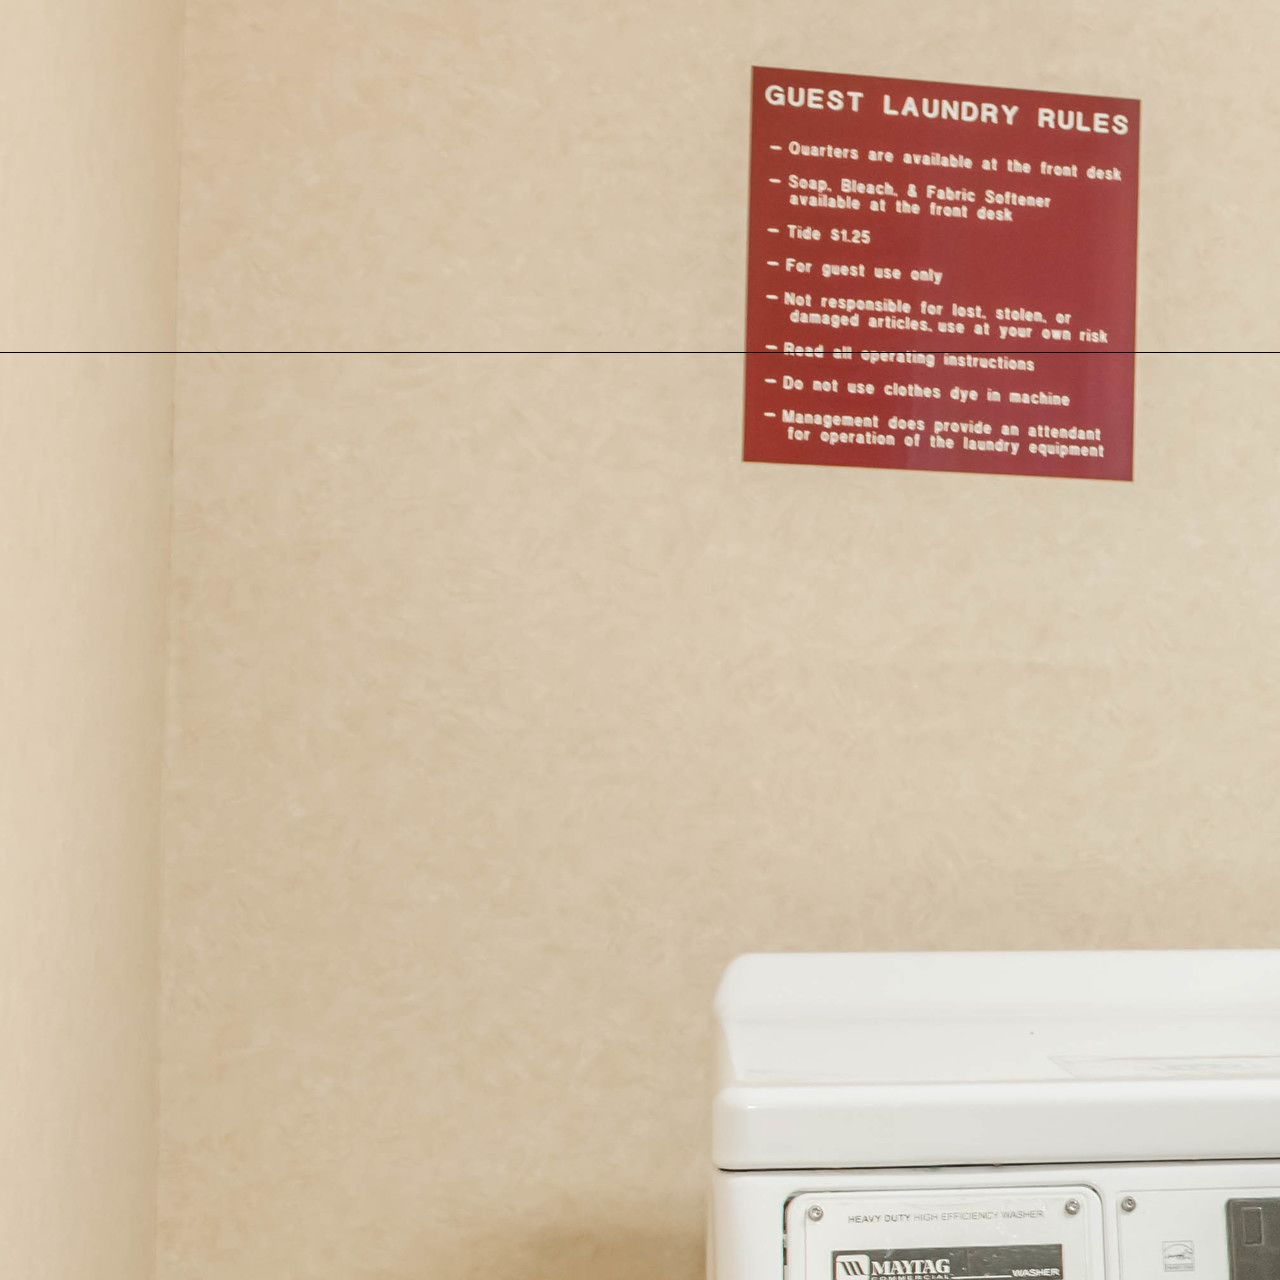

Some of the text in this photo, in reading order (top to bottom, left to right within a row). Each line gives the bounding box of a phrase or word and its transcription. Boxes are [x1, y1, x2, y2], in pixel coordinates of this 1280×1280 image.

[764, 84, 1128, 135] GUEST LAUNDRY RULES
[788, 140, 1121, 181] Quarters are available at the front desk
[789, 193, 1014, 221] available at the front desk
[906, 183, 917, 198] &
[926, 184, 975, 202] Fabric
[983, 189, 1051, 208] Softener
[786, 224, 821, 240] Tide
[785, 257, 943, 285] For guest use only
[783, 291, 811, 307] Not
[820, 295, 911, 315] responsible
[920, 300, 943, 315] for
[1055, 312, 1071, 324] or
[789, 310, 860, 328] damaged
[937, 321, 965, 334] use
[973, 322, 990, 335] at
[998, 325, 1032, 339] your
[1041, 328, 1071, 340] own
[1079, 328, 1108, 343] risk
[783, 341, 1034, 371] Read all operating instructions
[782, 375, 1070, 406] Do not use clothes dye in machine
[781, 409, 1101, 441] Management does provide an attendant
[787, 426, 1104, 458] for operation of the laundry equipment
[848, 1209, 1045, 1223] HEAVY DUTY HIGH EFFICIENCY WASHER
[871, 1259, 951, 1276] MAYTAG
[1012, 1268, 1060, 1278] WASHER
